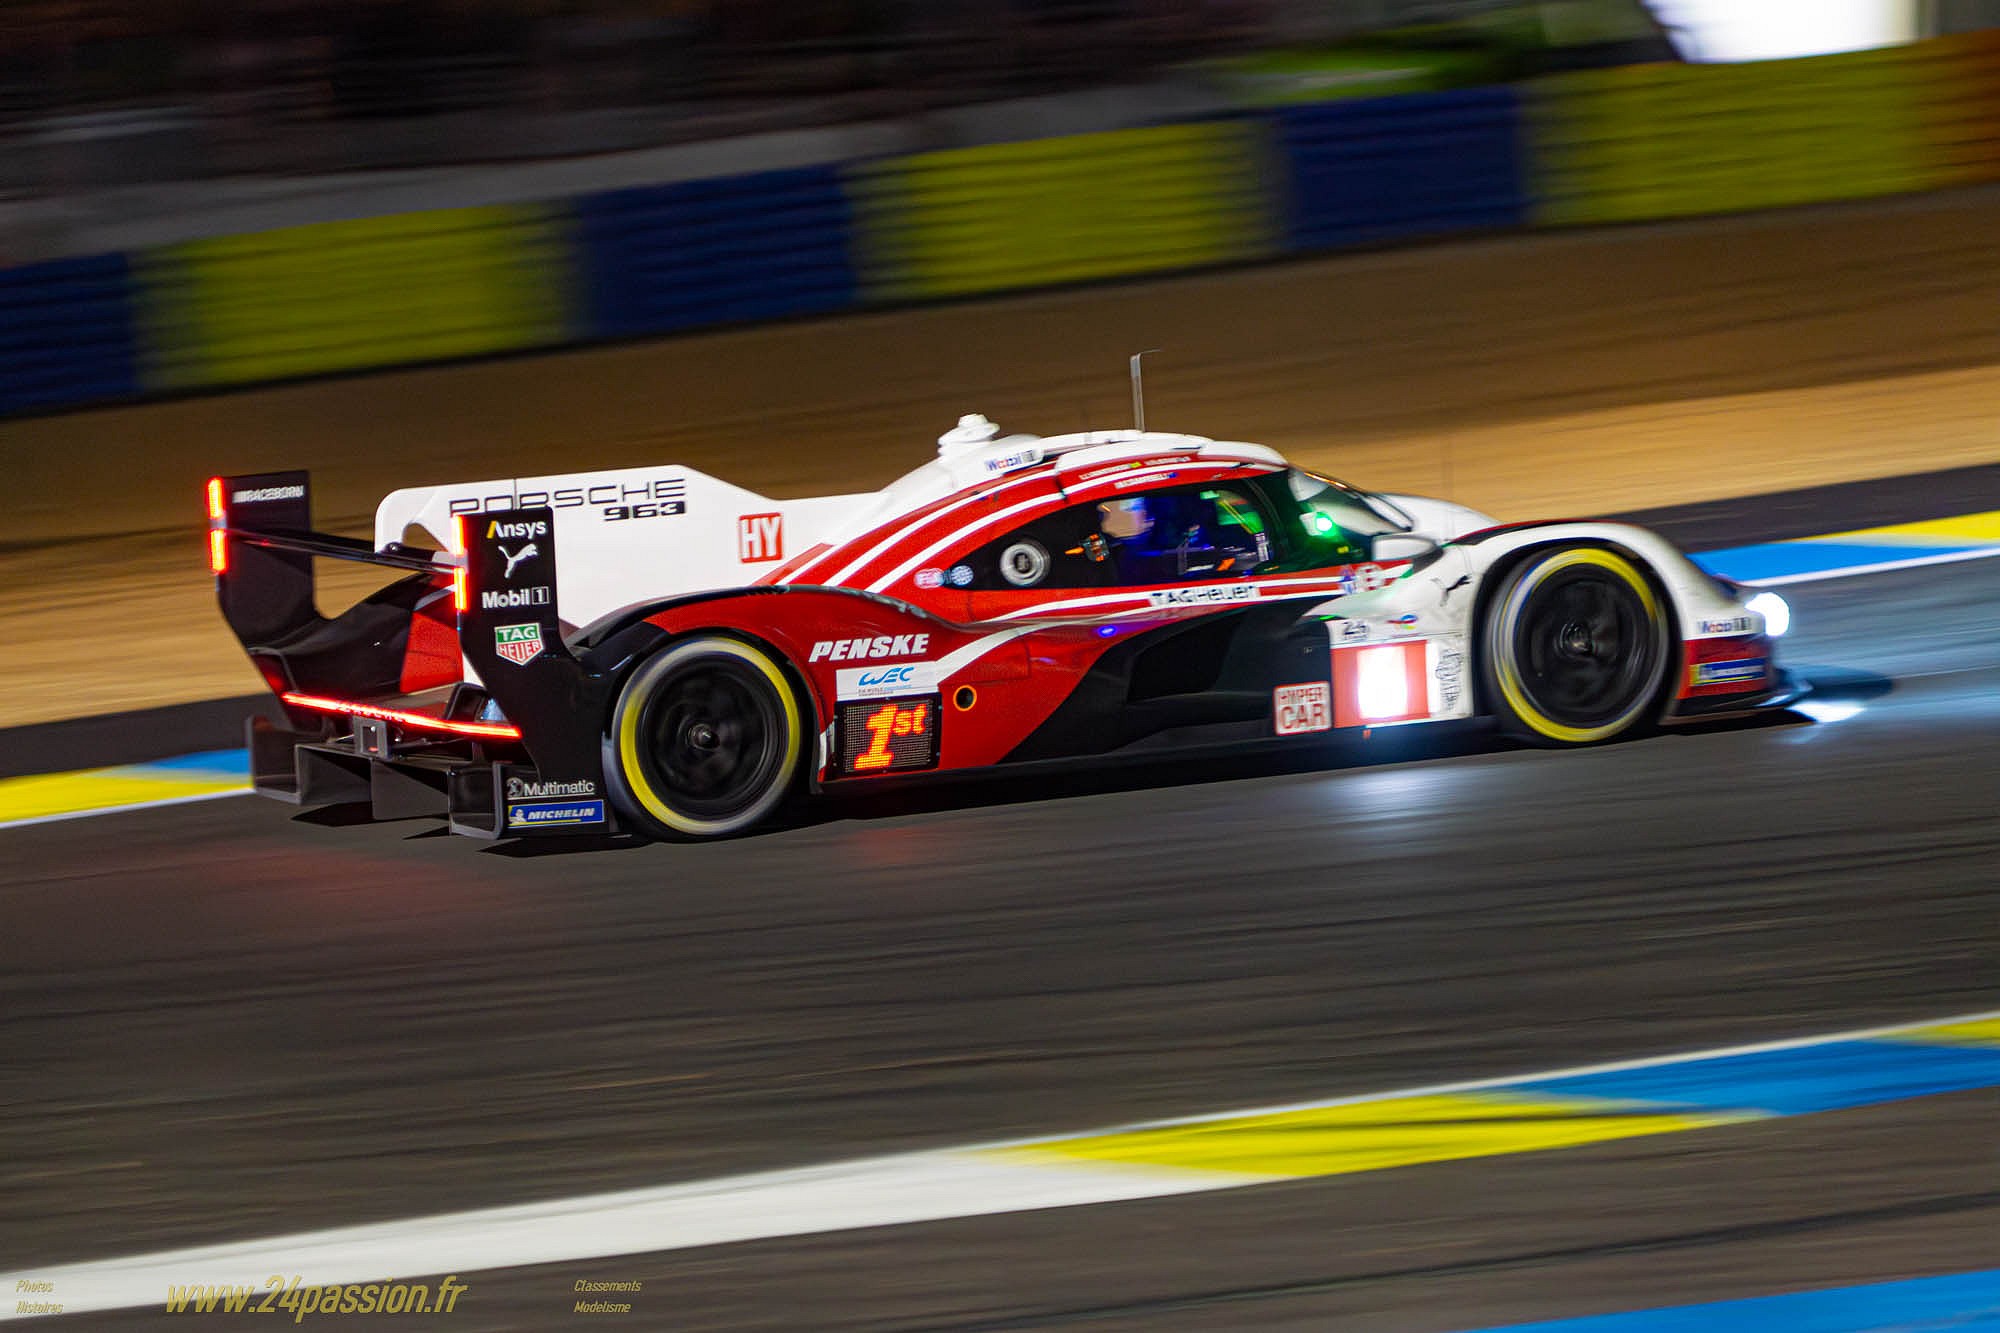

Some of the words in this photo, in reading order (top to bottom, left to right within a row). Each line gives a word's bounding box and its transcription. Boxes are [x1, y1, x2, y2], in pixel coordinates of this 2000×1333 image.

[450, 479, 685, 516] PORSCHE
[603, 501, 686, 521] 963
[486, 520, 547, 539] Ansys
[741, 516, 781, 560] HY
[482, 588, 530, 609] Mobil
[499, 627, 537, 643] TAG
[499, 640, 540, 661] HEUER
[808, 633, 929, 663] PENSKE
[858, 667, 914, 686] WEC
[1278, 687, 1325, 704] HYPER
[1280, 703, 1327, 730] CAR
[854, 703, 928, 770] 1st
[524, 780, 594, 796] Multimatic
[528, 808, 595, 820] MICHELIN
